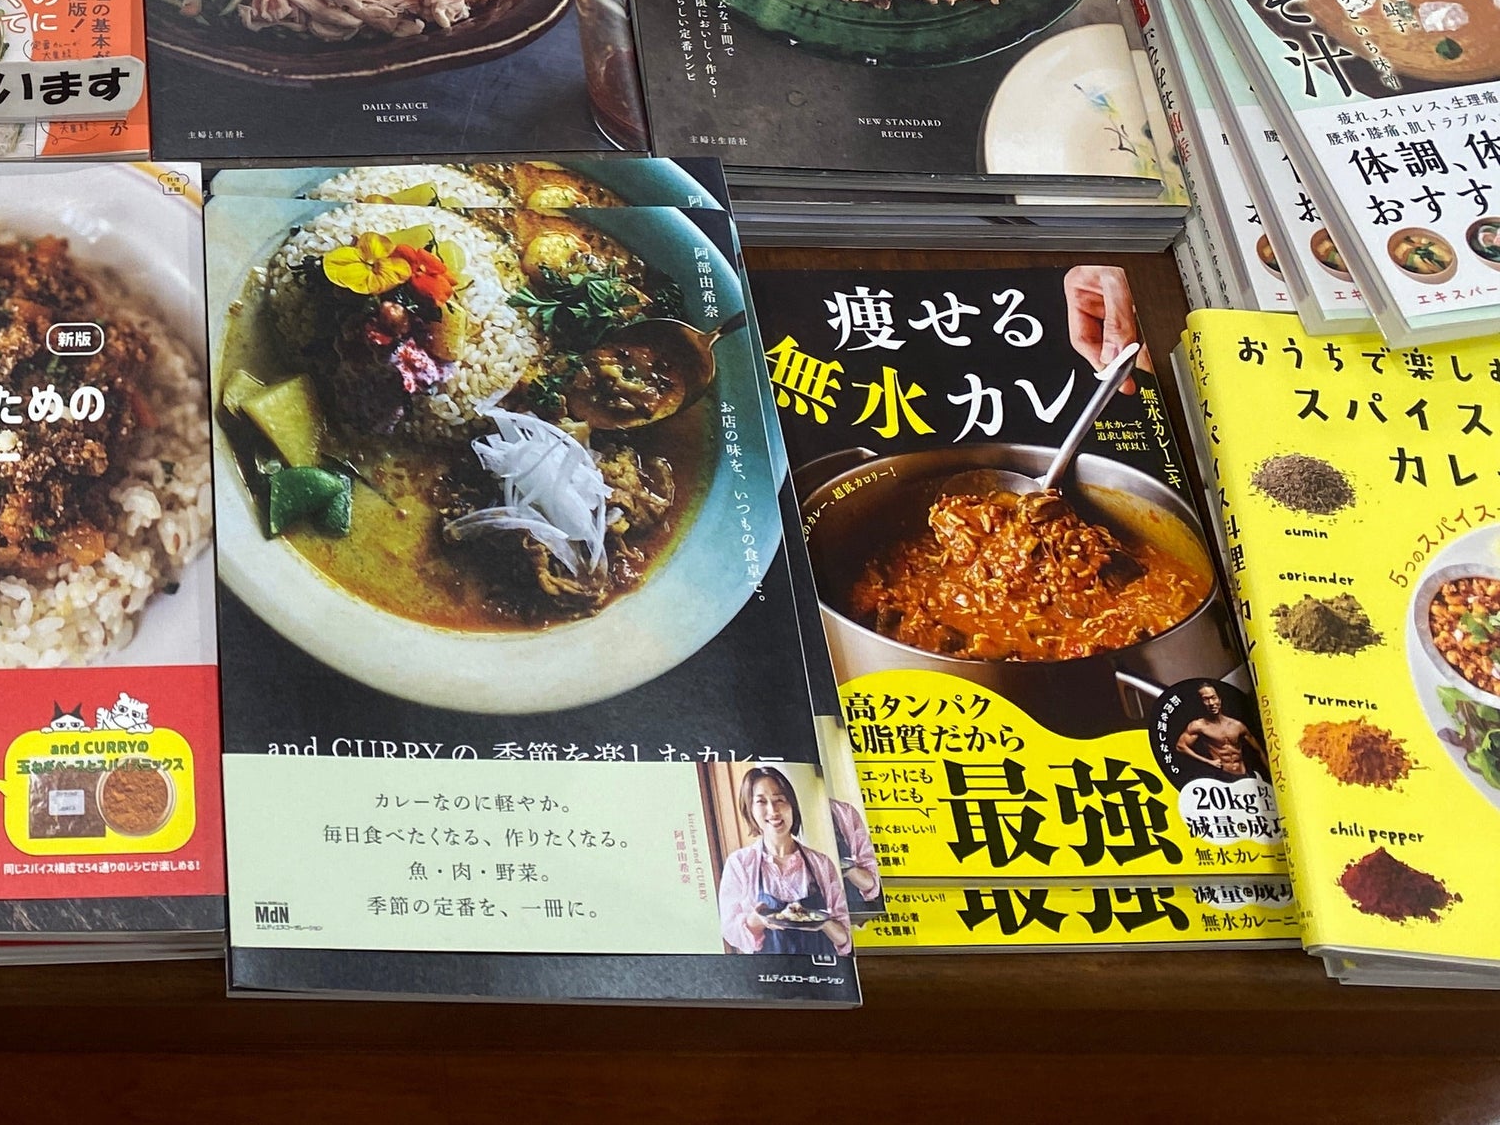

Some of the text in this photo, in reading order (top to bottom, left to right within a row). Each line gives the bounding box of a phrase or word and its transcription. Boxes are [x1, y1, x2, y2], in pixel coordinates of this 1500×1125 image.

[362, 101, 428, 112] DAILY SAUCE
[376, 113, 418, 123] RECIPES
[858, 116, 941, 127] NEW STANDARD
[880, 130, 924, 140] RECIPES
[823, 285, 1044, 352] 痩せる
[57, 330, 92, 348] 新版
[1294, 388, 1495, 437] スパイス
[1284, 526, 1329, 540] cumin
[1278, 571, 1355, 586] coriander
[846, 692, 991, 723] 高タンパク
[1303, 693, 1379, 712] Turmeric
[50, 739, 80, 756] and
[373, 792, 573, 816] カレーなのに軽やか。
[937, 757, 1184, 869] 最強
[322, 824, 631, 849] 毎日食べたくなる、作りたくなる。
[1330, 821, 1425, 845] chili pepper
[407, 860, 553, 885] 魚・肉・野菜。
[254, 904, 290, 925] MdN
[366, 895, 602, 921] 季節の定番を、一冊に。
